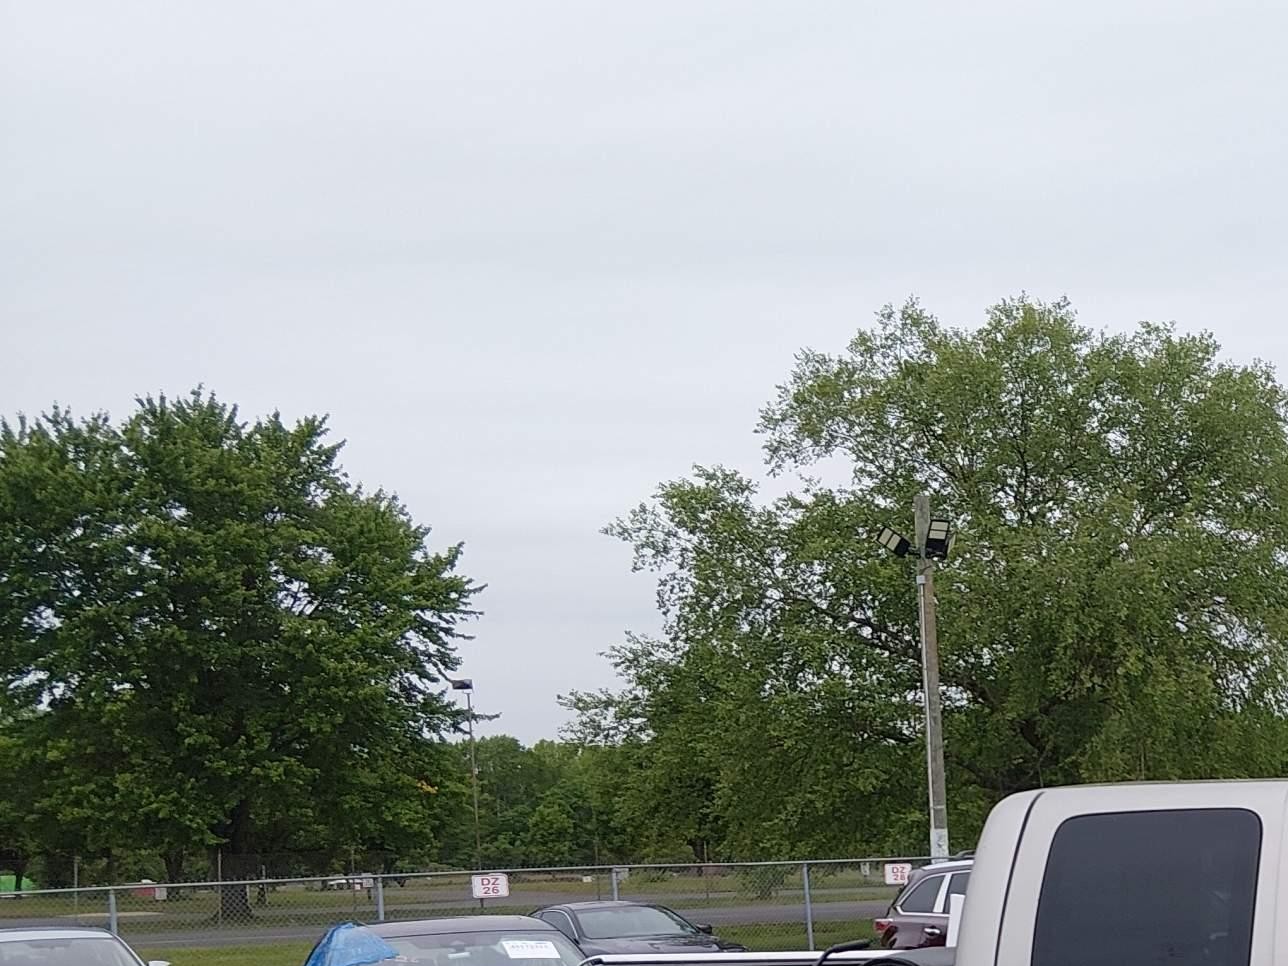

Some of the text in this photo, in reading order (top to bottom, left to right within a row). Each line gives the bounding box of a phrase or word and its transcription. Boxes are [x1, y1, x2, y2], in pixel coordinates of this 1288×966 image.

[891, 866, 905, 874] DZ
[481, 877, 500, 886] DZ
[482, 886, 500, 895] 26
